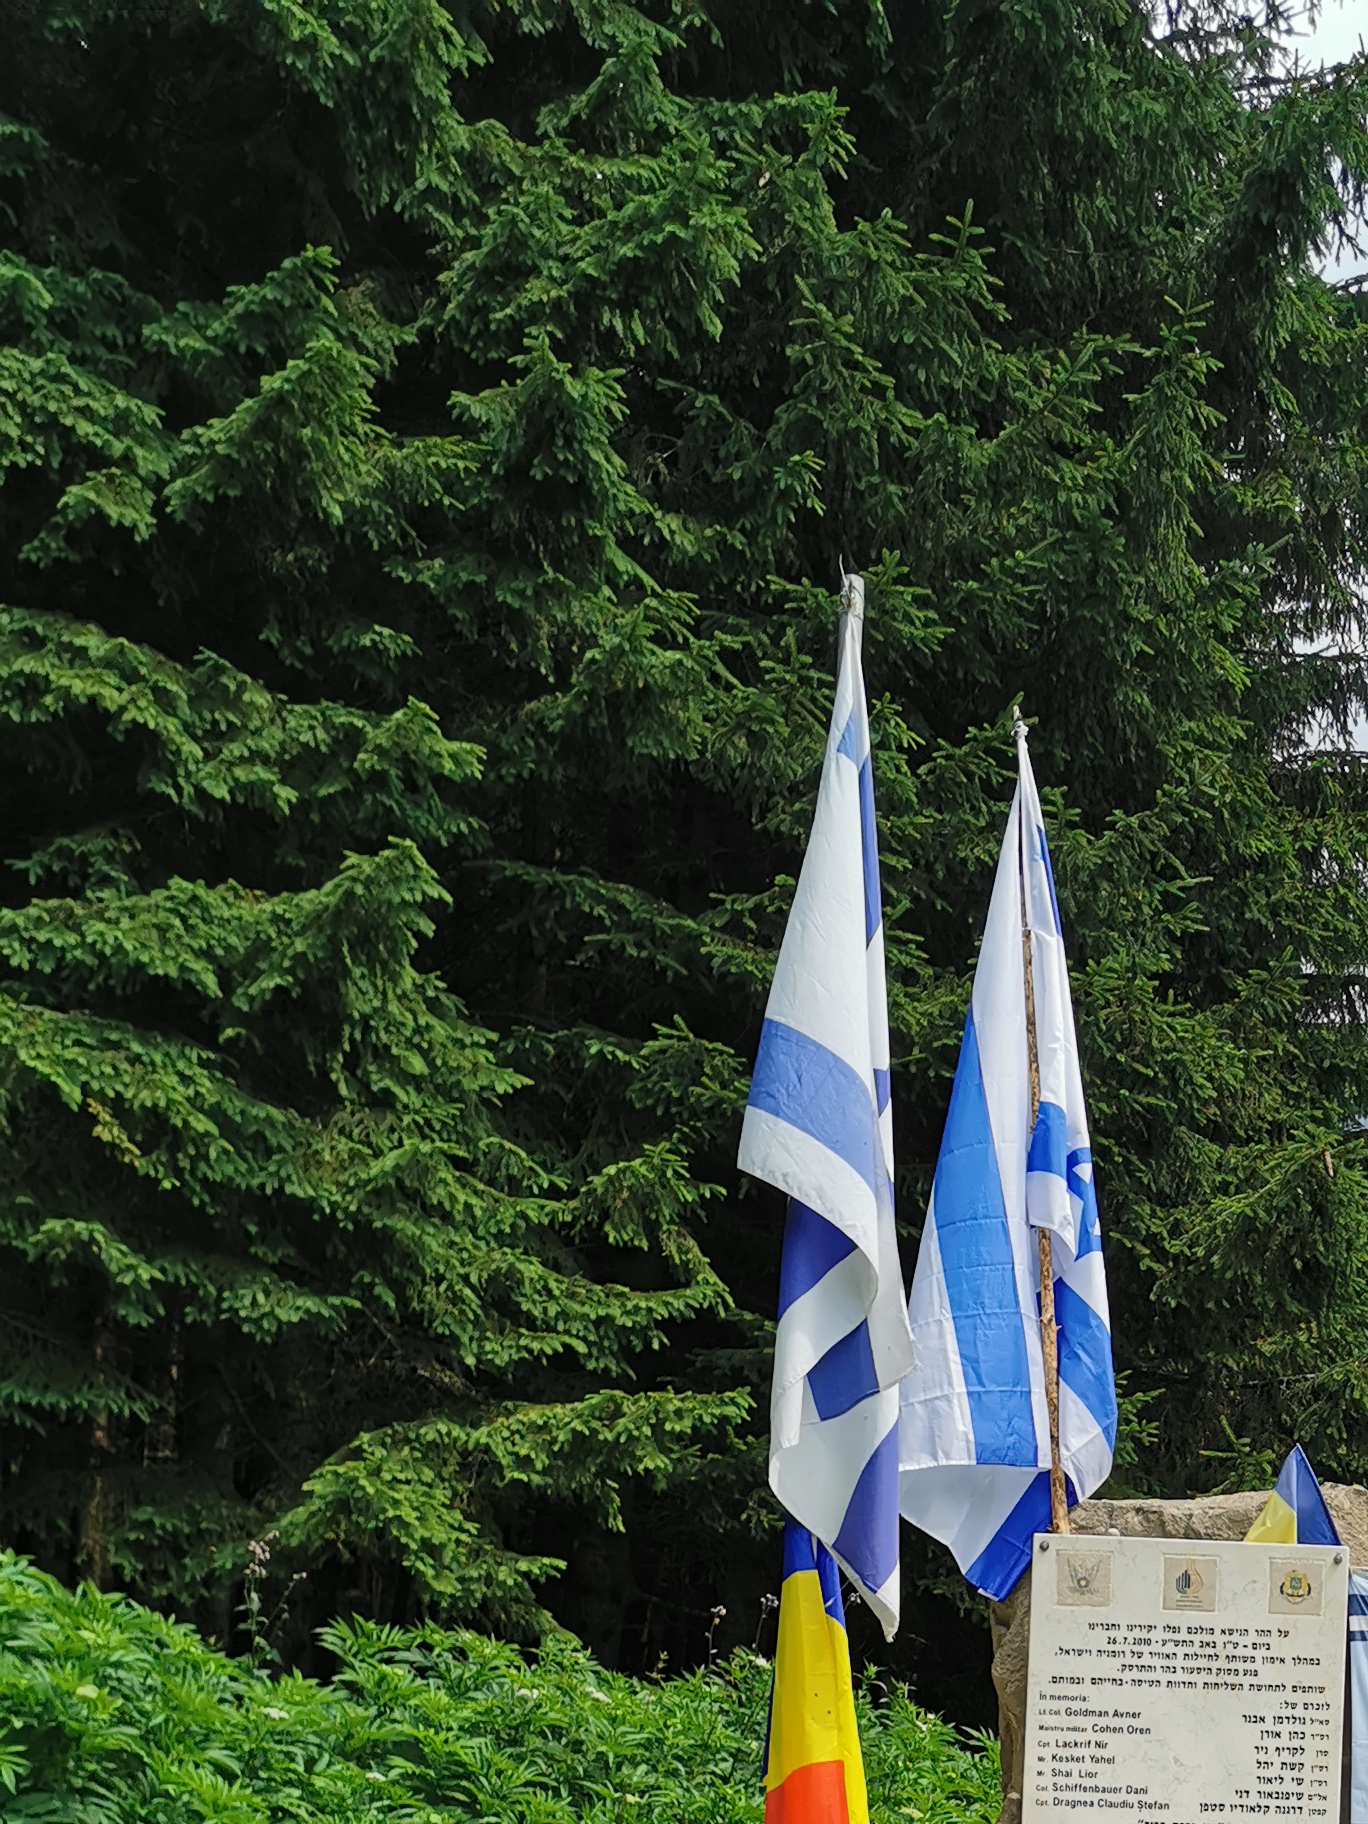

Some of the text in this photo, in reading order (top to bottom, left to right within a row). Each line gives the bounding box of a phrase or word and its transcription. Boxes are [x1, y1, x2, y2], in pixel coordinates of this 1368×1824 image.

[1087, 1622, 1290, 1638] על ההר הנישא מולכם נפלו יקירינו וחברינו
[1198, 1640, 1216, 1649] באב
[1251, 1642, 1270, 1651] ביום
[1096, 1649, 1126, 1658] רומניה
[1129, 1648, 1144, 1659] של
[1148, 1651, 1177, 1660] האוויר
[1224, 1654, 1256, 1664] משותף
[1261, 1656, 1285, 1665] אימון
[1291, 1655, 1320, 1666] במהלך
[1159, 1665, 1176, 1674] בהר
[1180, 1666, 1212, 1675] היסעור
[1215, 1667, 1239, 1677] מסוק
[1242, 1668, 1258, 1677] פגע
[1165, 1680, 1197, 1689] וחדוות
[1202, 1680, 1243, 1691] השליחות
[1248, 1683, 1286, 1692] לתחושת
[1291, 1684, 1326, 1694] שותפים
[1302, 1701, 1330, 1711] לזכרם
[1064, 1707, 1141, 1719] Goldman Avner
[1241, 1714, 1265, 1724] אבנר
[1272, 1714, 1306, 1726] גולדמן
[1091, 1723, 1124, 1734] Cohen
[1126, 1724, 1151, 1735] Oren
[1259, 1729, 1281, 1740] אורן
[1288, 1730, 1305, 1741] כהן
[1055, 1738, 1108, 1749] Lackrif Nir
[1253, 1745, 1268, 1755] ניר
[1274, 1745, 1305, 1757] לקריף
[1088, 1754, 1115, 1764] Yahel
[1255, 1758, 1274, 1770] יהל
[1279, 1761, 1305, 1773] קשת
[1051, 1767, 1098, 1779] Shai Lior
[1255, 1774, 1284, 1785] ליאור
[1290, 1776, 1304, 1786] שי
[1051, 1782, 1148, 1795] Schiffenbauer Dani
[1234, 1789, 1250, 1799] דני
[1052, 1796, 1094, 1809] Dragnea
[1097, 1798, 1134, 1809] Claudiu
[1199, 1802, 1225, 1813] סטפן
[1229, 1802, 1270, 1815] קלאודיו
[1274, 1805, 1303, 1815] דרגנה
